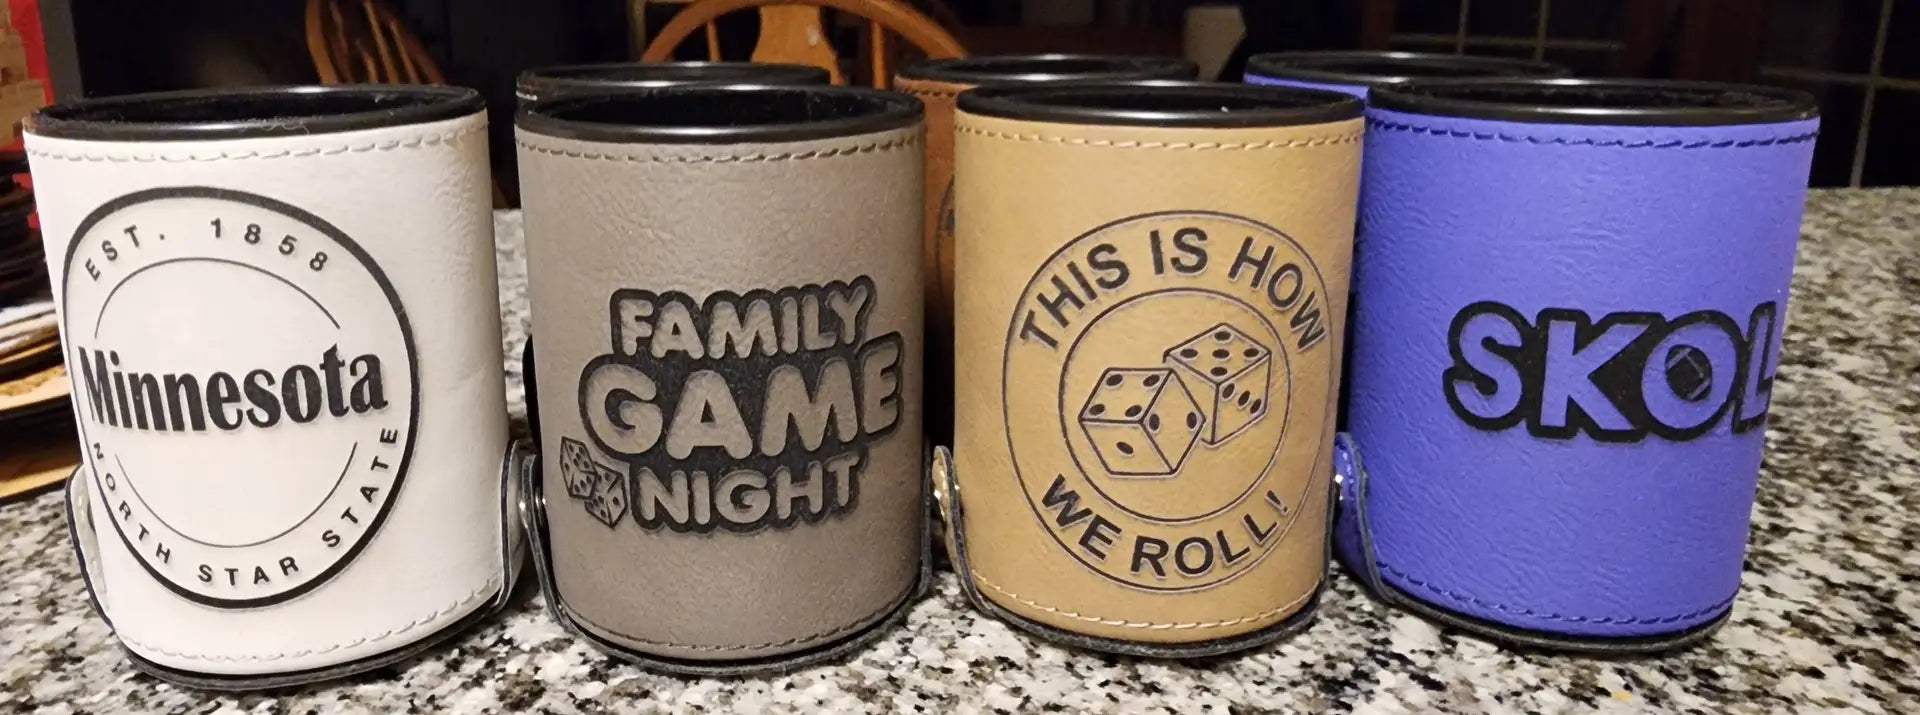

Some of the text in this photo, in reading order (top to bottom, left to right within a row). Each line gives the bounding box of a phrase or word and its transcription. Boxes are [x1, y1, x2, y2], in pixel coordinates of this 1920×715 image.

[85, 218, 329, 281] EST. 1858
[1018, 226, 1326, 353] THIS IS HOW
[615, 281, 870, 360] FAMILY
[1447, 305, 1776, 438] SKOL
[78, 343, 388, 432] Minnesota
[582, 341, 900, 461] GAME
[92, 427, 399, 587] NORTH STAR STATE
[636, 453, 861, 526] NIGHT
[1041, 472, 1291, 578] WE ROLL!
